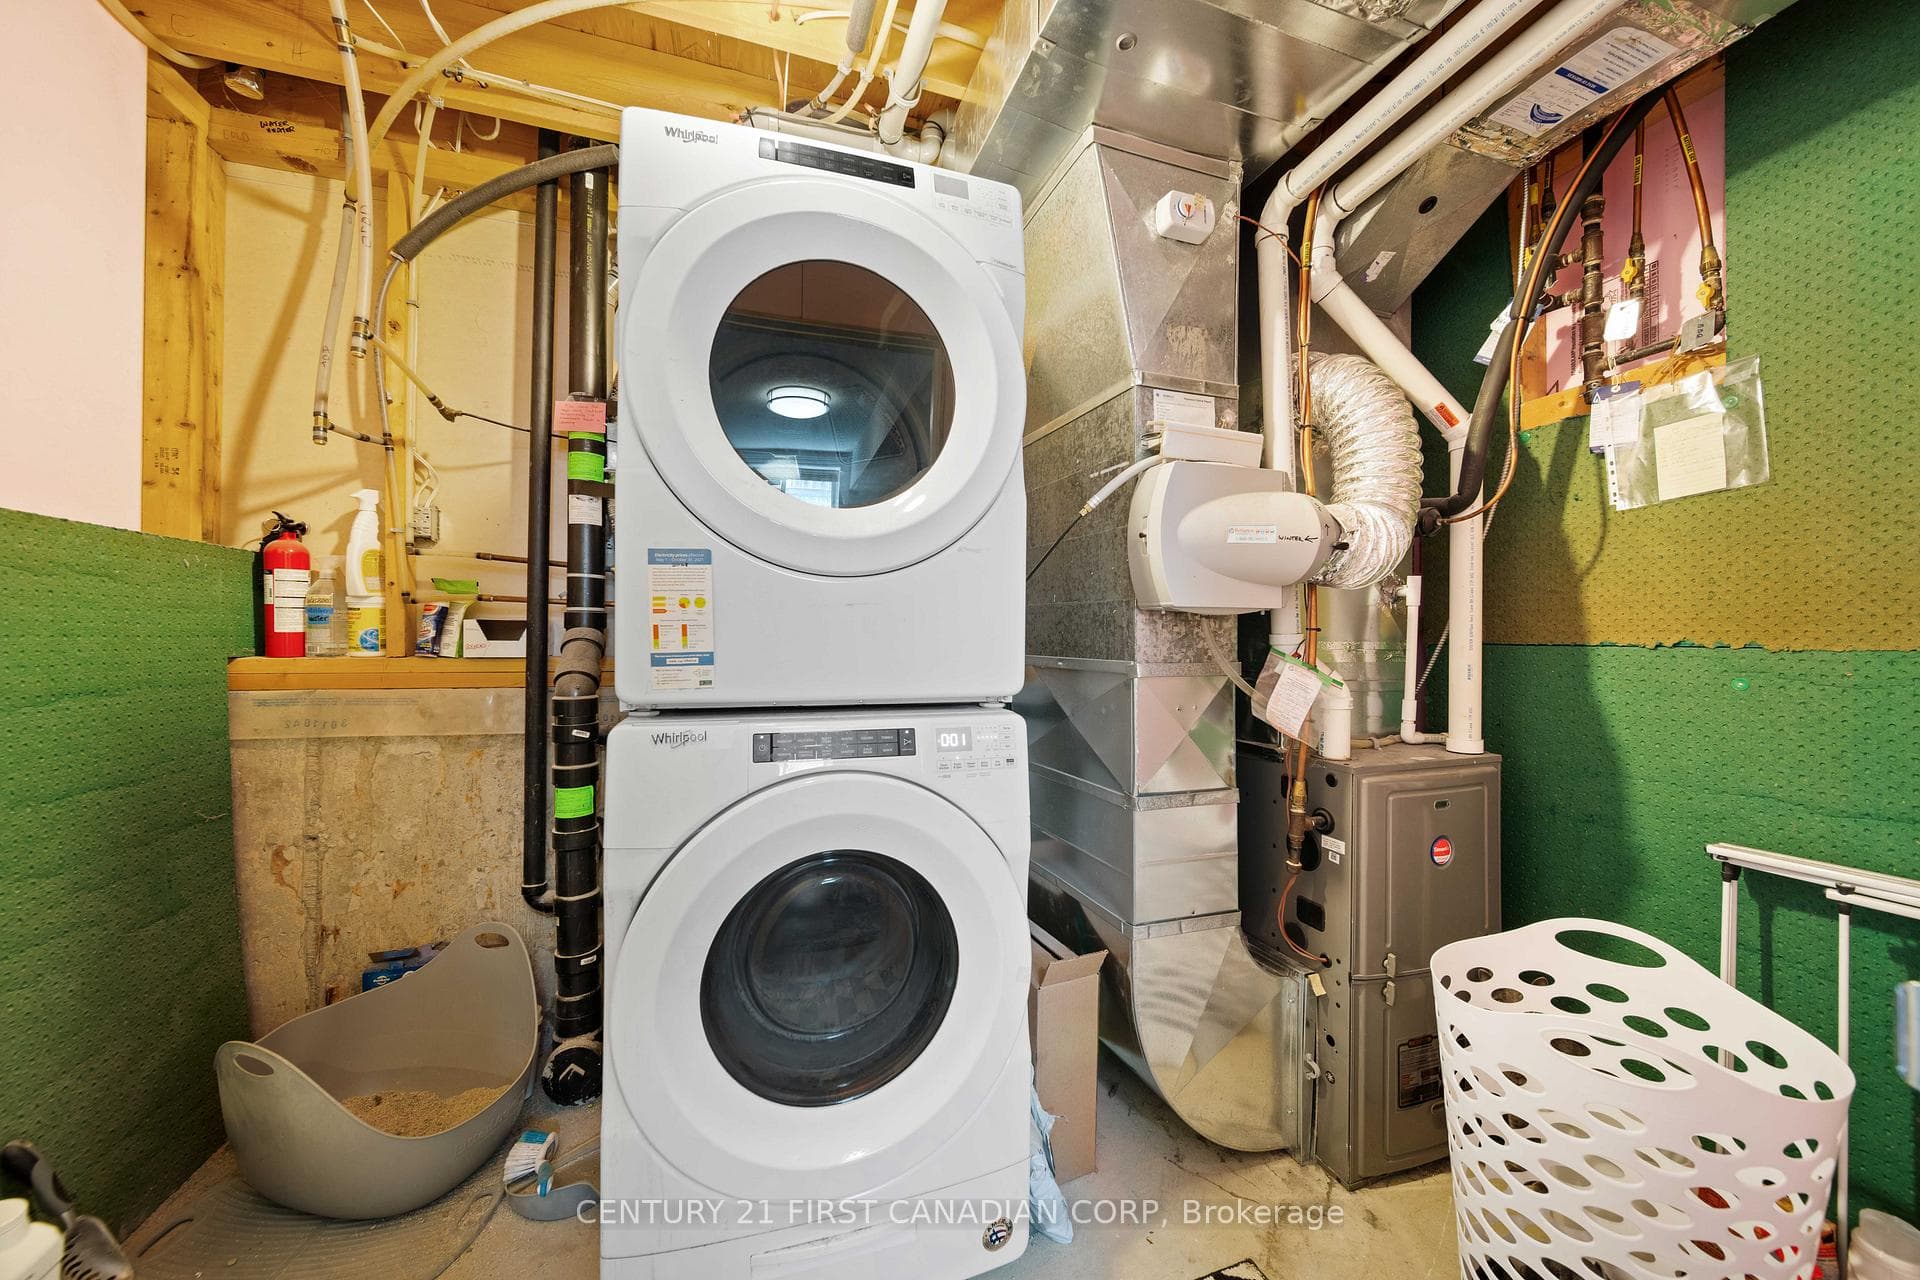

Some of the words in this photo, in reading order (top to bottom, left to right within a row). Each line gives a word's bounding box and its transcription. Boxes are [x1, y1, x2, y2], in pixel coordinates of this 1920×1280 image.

[260, 120, 289, 128] WATER
[664, 126, 720, 144] Whirlpool
[651, 729, 707, 749] Whirlpool
